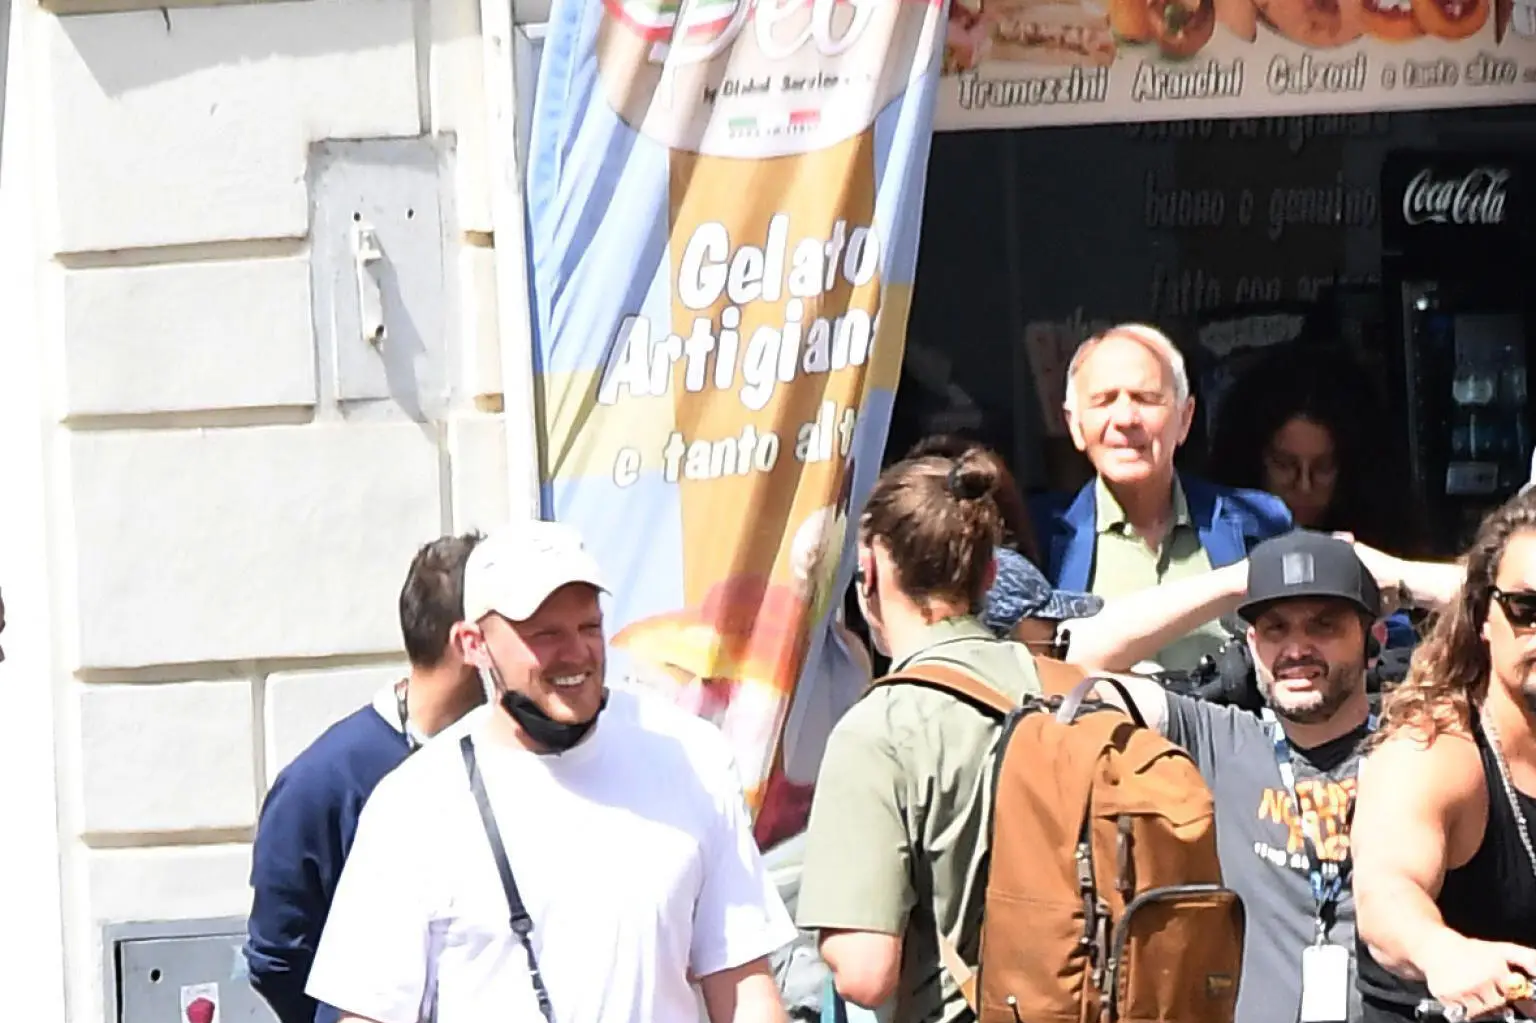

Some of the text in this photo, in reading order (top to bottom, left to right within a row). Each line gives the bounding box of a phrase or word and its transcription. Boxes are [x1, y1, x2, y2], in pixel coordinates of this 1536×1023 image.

[957, 64, 1111, 110] Tramezzini
[678, 213, 880, 310] Gelato
[599, 298, 883, 411] Artigian
[613, 446, 642, 488] e
[663, 424, 780, 483] tanto
